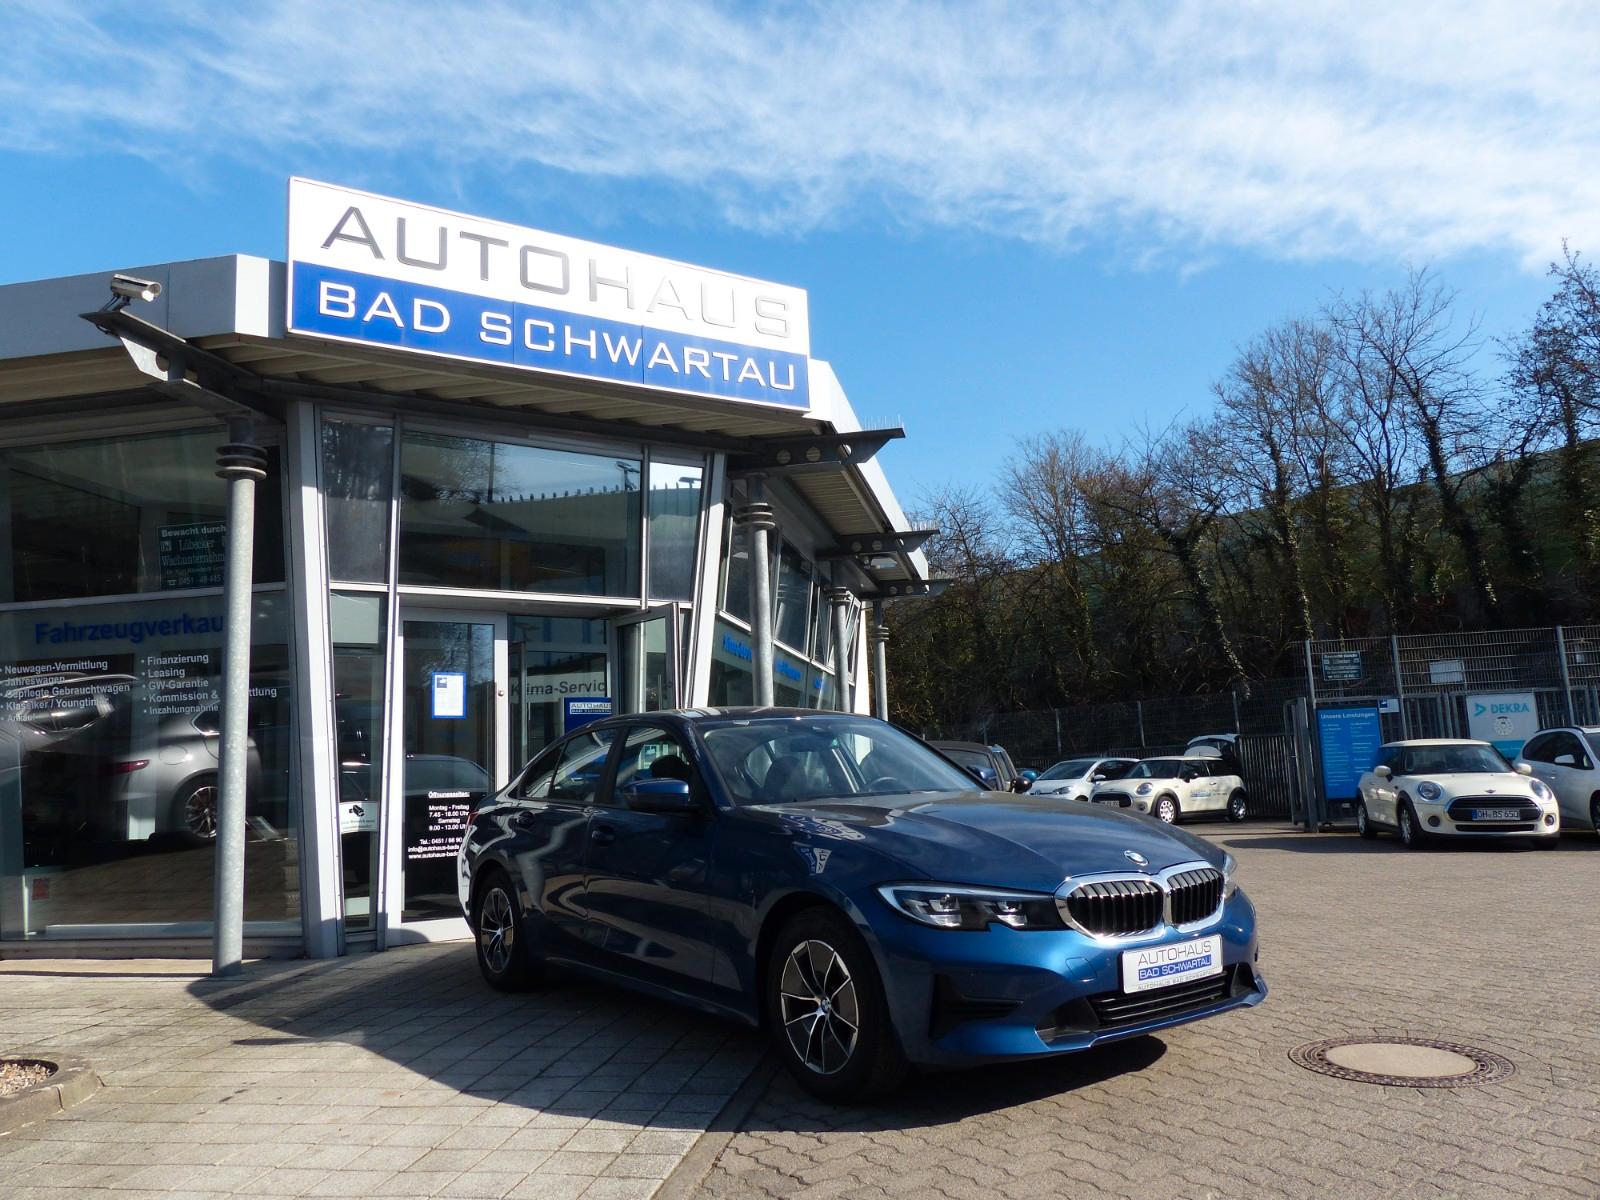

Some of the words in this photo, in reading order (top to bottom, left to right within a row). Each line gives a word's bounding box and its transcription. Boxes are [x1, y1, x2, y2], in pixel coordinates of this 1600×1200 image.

[320, 205, 791, 339] AUTOHAUS
[319, 280, 450, 334] BAD
[479, 312, 795, 391] SCHWARTAU
[36, 613, 224, 645] Fahrzeugverkau
[4, 660, 108, 675] Neuwagen-Vermittlung
[147, 654, 209, 666] Finanzierung
[5, 675, 66, 687] Jahreswagen
[148, 668, 185, 679] Leasing
[52, 683, 130, 698] Gebrauchtwagen
[148, 679, 209, 691] GW-Garantie
[511, 679, 606, 697] Kima-Servic
[149, 692, 208, 703] Kommission
[211, 690, 218, 699] &
[149, 703, 219, 715] Inzahlungnahme
[1490, 703, 1530, 714] DEKRA
[1138, 940, 1212, 967] AUTOHAUS
[1139, 967, 1160, 979] BAD
[1161, 956, 1211, 975] SCHWARTAU
